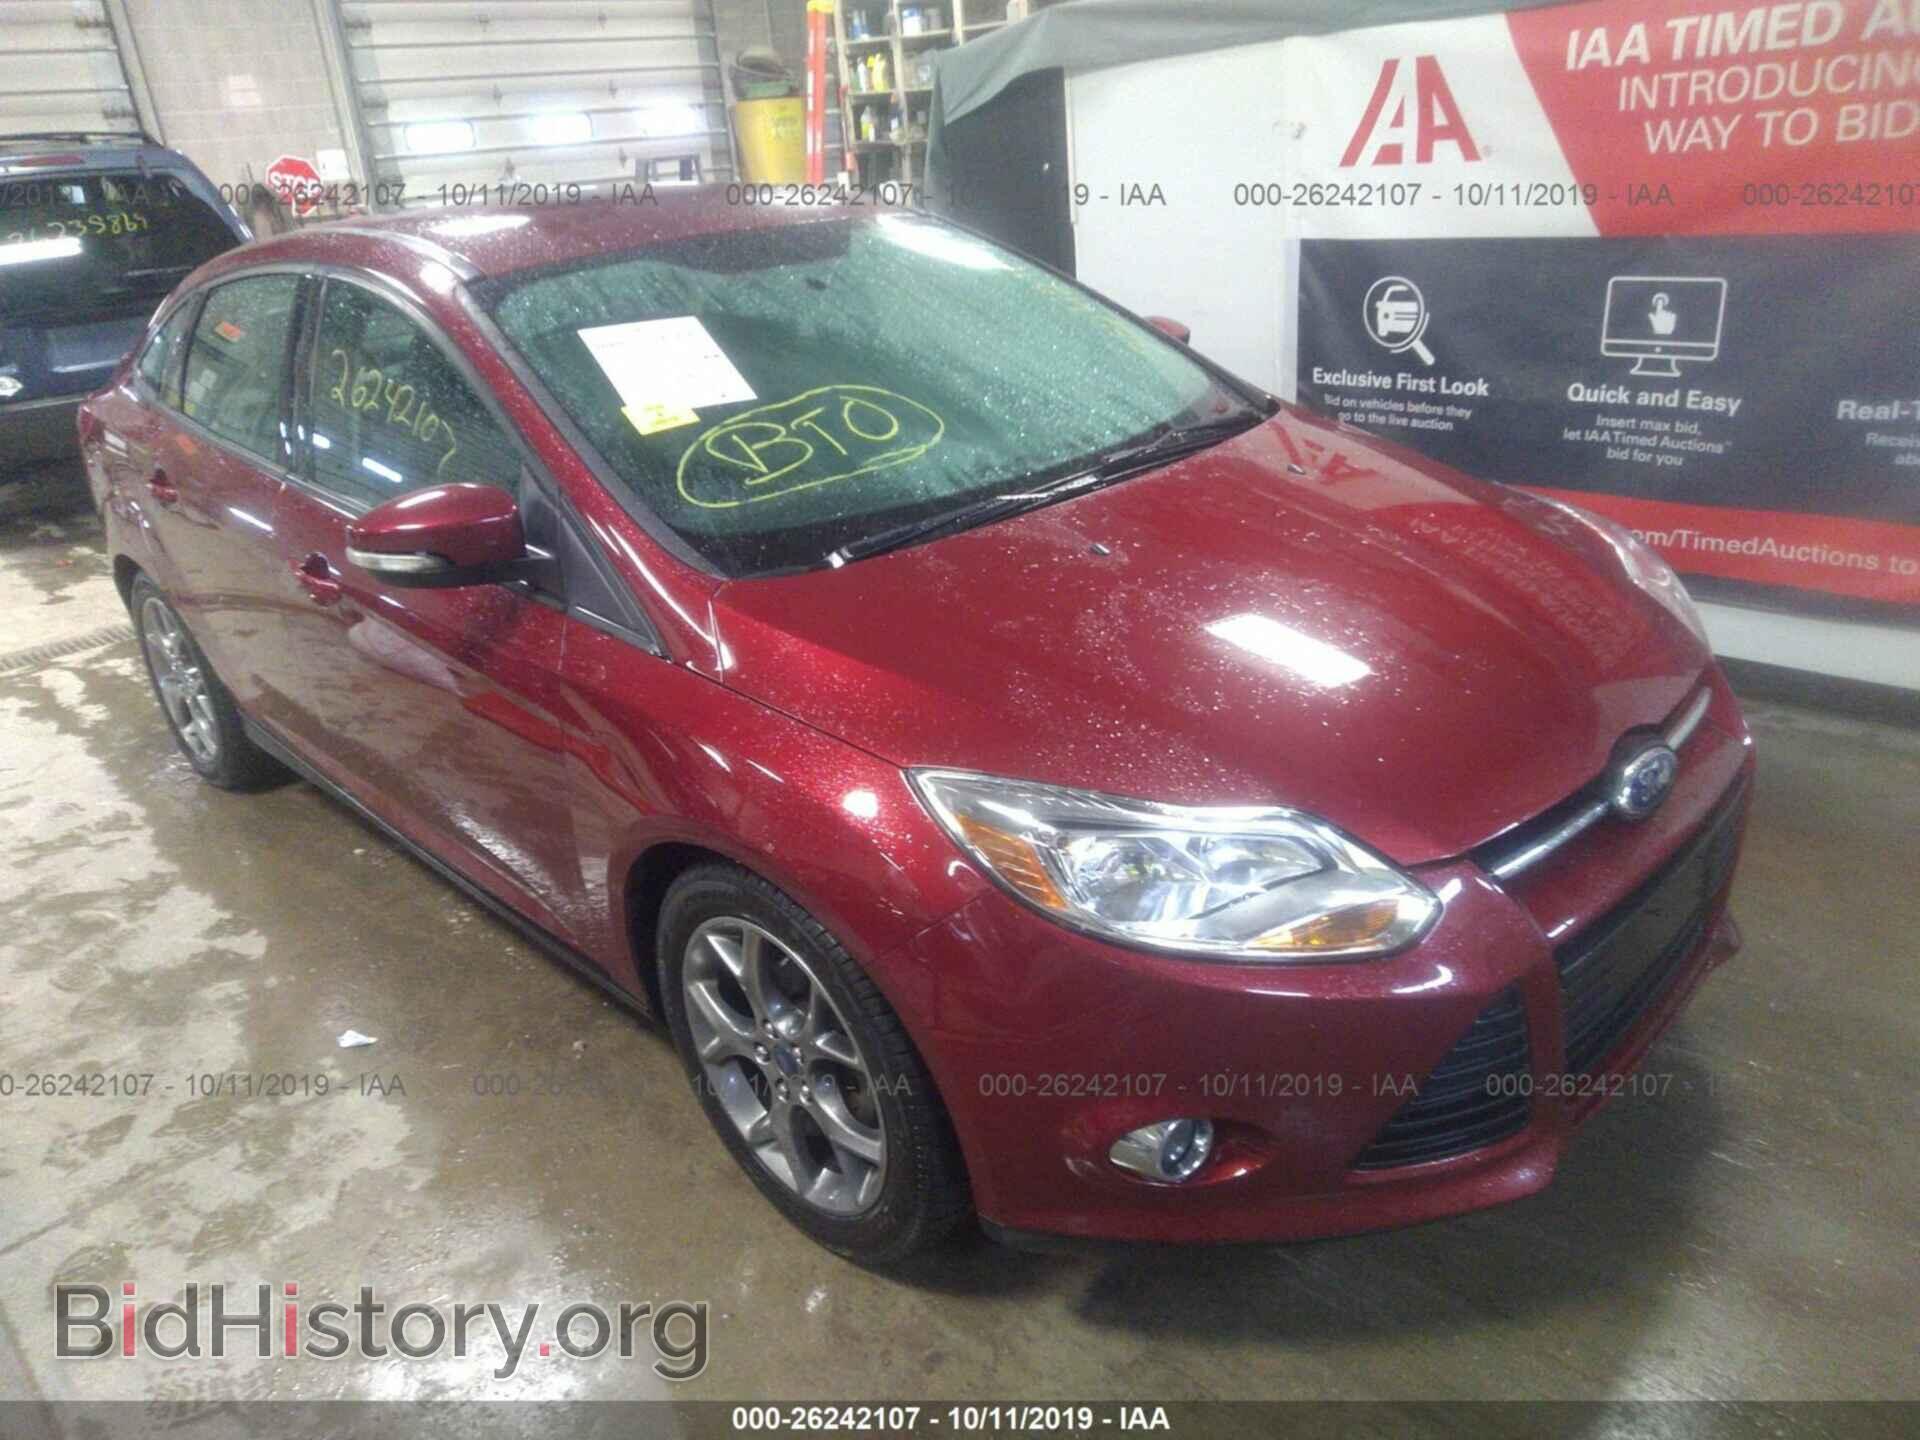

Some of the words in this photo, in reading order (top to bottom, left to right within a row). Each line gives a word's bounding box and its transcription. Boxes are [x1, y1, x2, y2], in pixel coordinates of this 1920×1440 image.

[1566, 22, 1650, 70] IAA
[1665, 0, 1843, 61] TIMED
[1644, 114, 1743, 154] WAY
[1755, 107, 1819, 147] TO
[1836, 100, 1920, 142] BID
[269, 171, 320, 198] STOP
[1312, 367, 1392, 389] Exclusive
[1396, 372, 1436, 393] First
[1440, 377, 1490, 397] Look
[1342, 398, 1357, 408] on
[1359, 398, 1405, 412] vehicles
[1407, 401, 1444, 416] before
[1445, 405, 1473, 420] they
[1567, 382, 1632, 404] Quick
[1636, 388, 1680, 408] and
[1686, 390, 1743, 417] Easy
[1354, 411, 1366, 423] to
[1368, 412, 1387, 425] the
[1410, 417, 1454, 432] auction
[1596, 414, 1637, 430] Insert
[1639, 418, 1671, 432] max
[1563, 428, 1582, 441] let
[1584, 430, 1612, 443] IAA
[1613, 431, 1659, 447] Timed
[1606, 447, 1630, 460] bid
[1632, 448, 1653, 462] for
[1655, 453, 1684, 467] you
[1888, 555, 1919, 576] to
